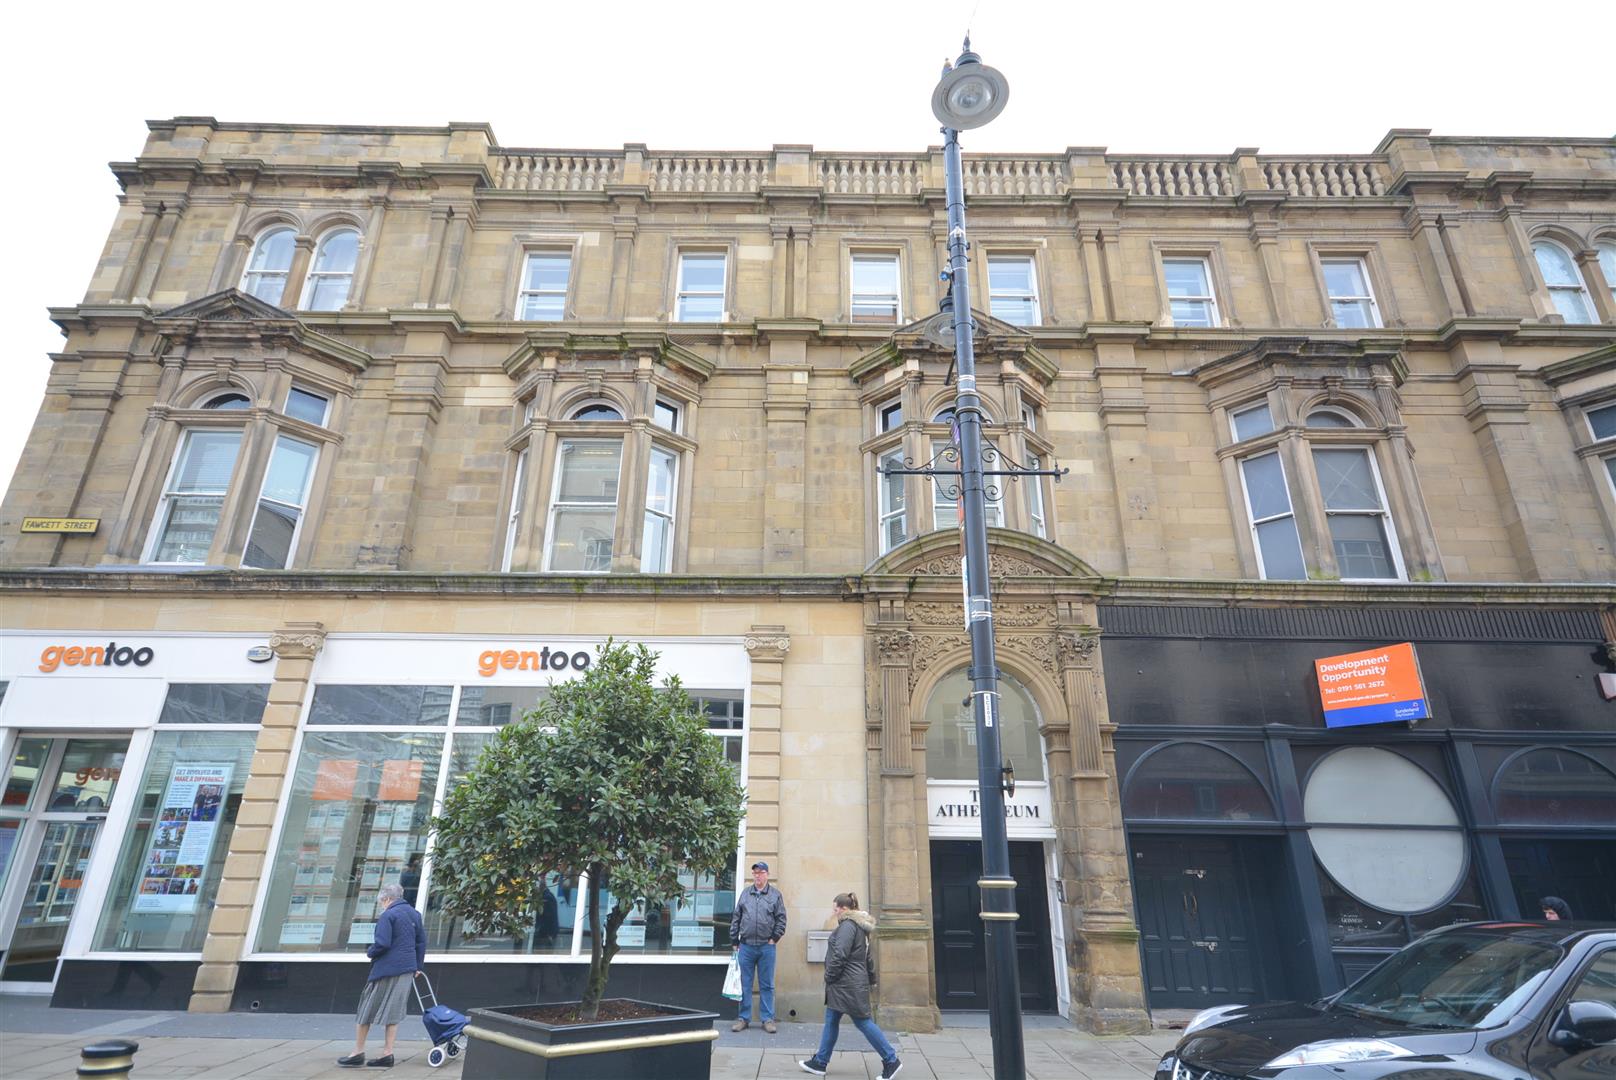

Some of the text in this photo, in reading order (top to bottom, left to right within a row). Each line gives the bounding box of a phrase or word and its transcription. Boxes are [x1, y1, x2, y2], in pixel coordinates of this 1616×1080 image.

[25, 520, 95, 529] FAWCETT STREET
[38, 642, 154, 673] gentoo
[478, 646, 591, 677] gentoo
[1320, 654, 1390, 673] Development
[1322, 665, 1387, 682] Opportunity
[936, 804, 1040, 818] ATHEEUM
